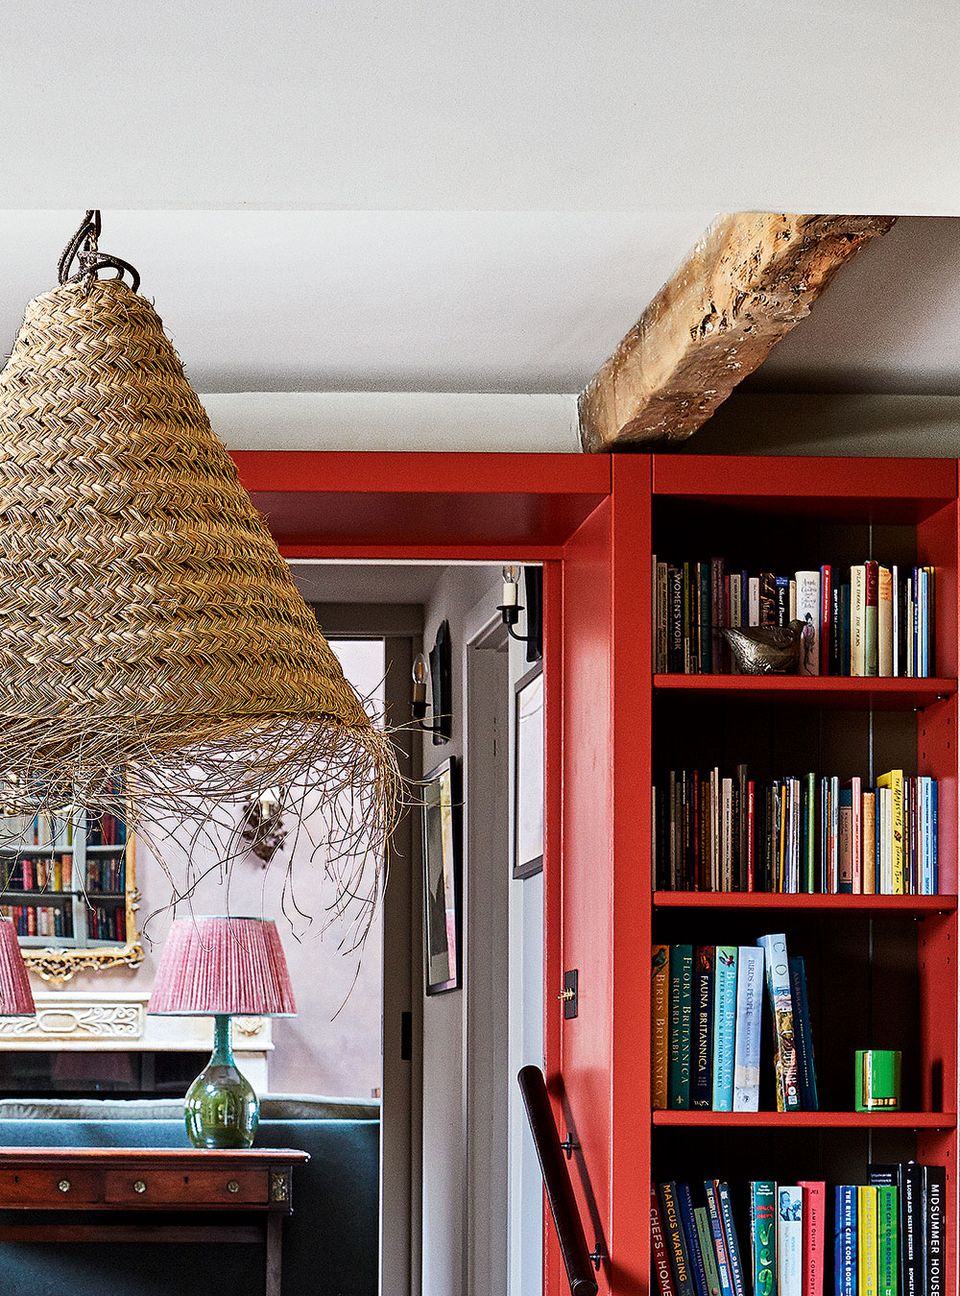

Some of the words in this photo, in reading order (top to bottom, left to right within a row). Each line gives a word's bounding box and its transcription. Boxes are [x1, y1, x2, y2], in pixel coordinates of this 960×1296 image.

[672, 977, 680, 1024] RICHARD
[700, 975, 709, 1008] FAUNA
[746, 988, 754, 1016] PEOPLE
[672, 1029, 680, 1063] MABEY
[698, 1012, 707, 1071] BRITANNICA
[649, 1208, 664, 1249] CHEFS
[663, 1185, 678, 1229] MARCUS
[671, 1232, 687, 1282] WAREING
[930, 1184, 940, 1253] MIDSUMMER
